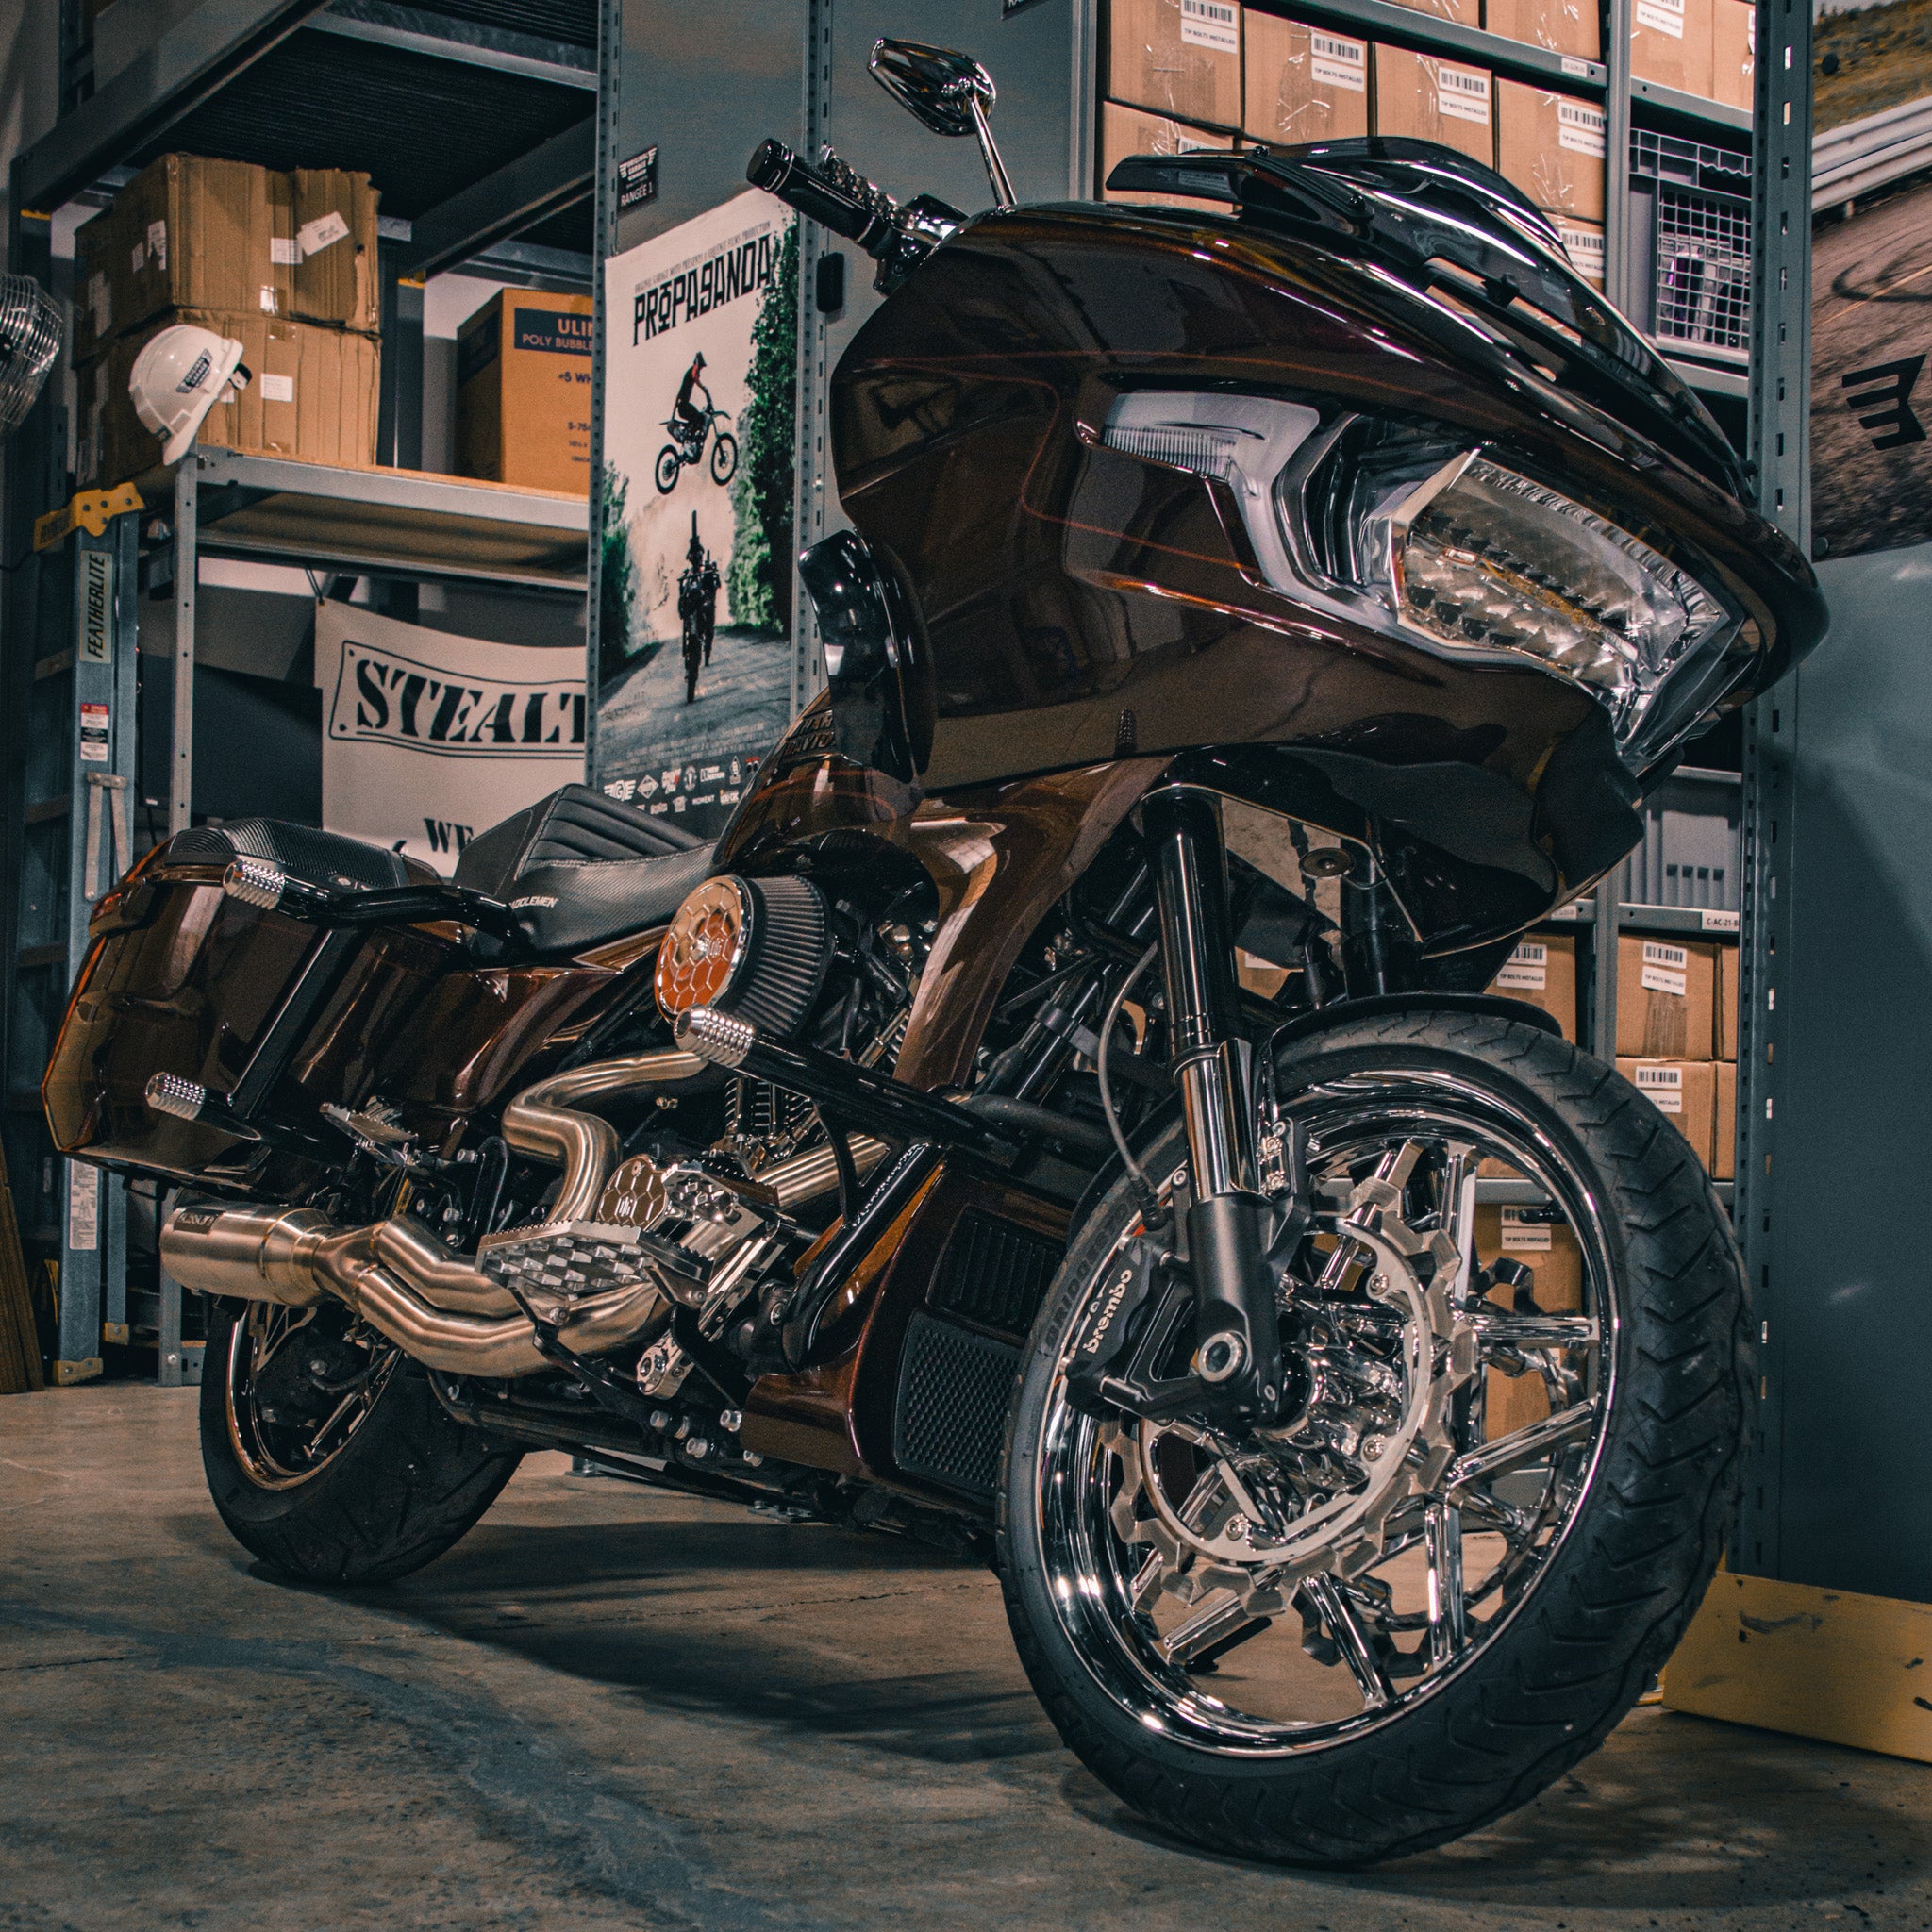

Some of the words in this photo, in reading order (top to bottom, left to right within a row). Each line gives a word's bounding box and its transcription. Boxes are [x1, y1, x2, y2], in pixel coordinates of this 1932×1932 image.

[649, 181, 653, 194] 1
[522, 333, 552, 347] POLY
[87, 553, 106, 659] FEATHERLITE
[1082, 1269, 1133, 1355] brembo
